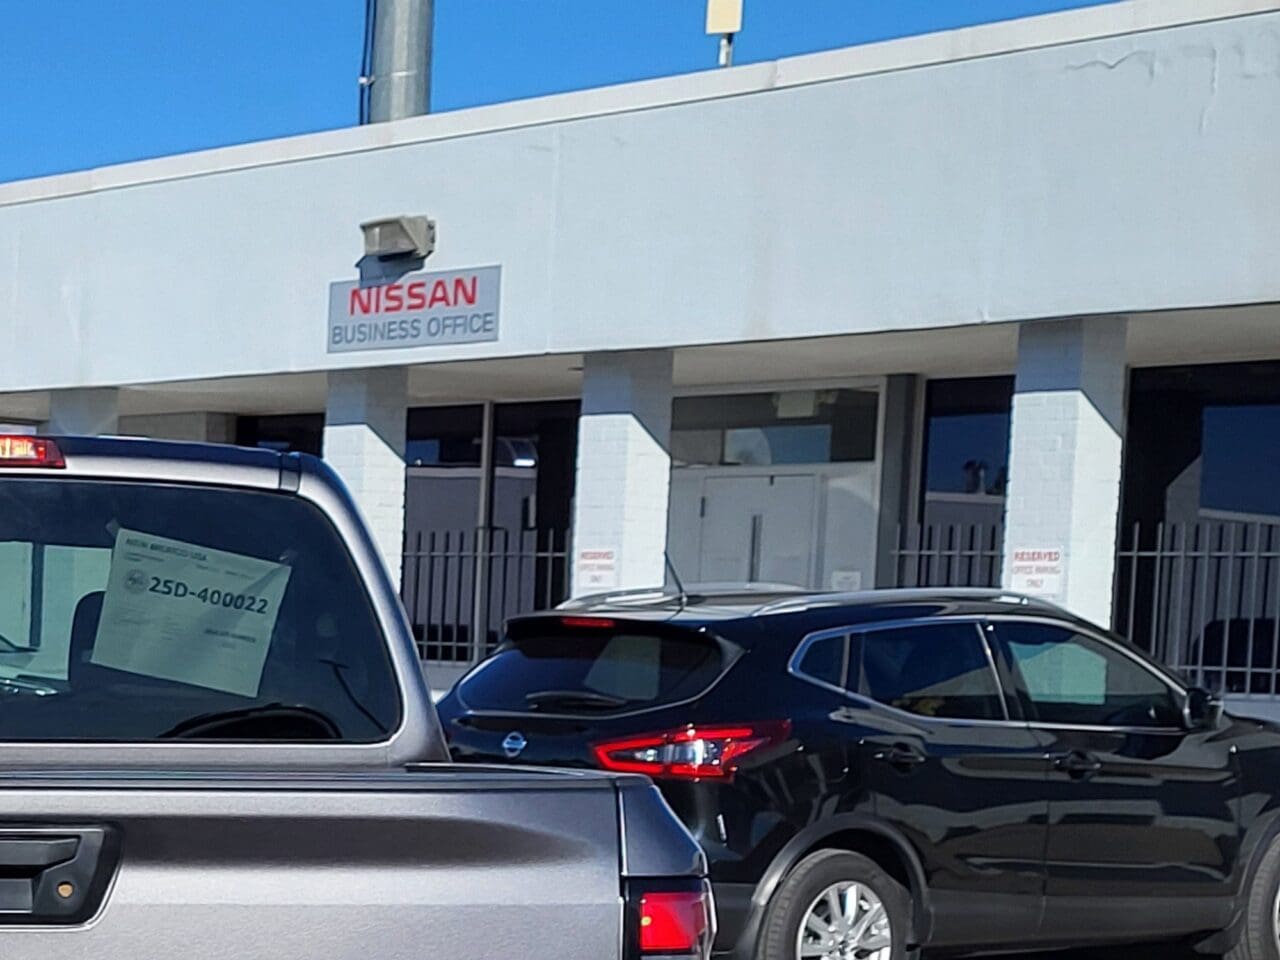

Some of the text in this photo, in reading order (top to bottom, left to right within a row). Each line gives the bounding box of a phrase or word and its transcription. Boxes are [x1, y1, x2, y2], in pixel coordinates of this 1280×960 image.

[349, 276, 478, 316] NISSAN
[331, 312, 495, 345] BUSINESS OFFICE
[1014, 551, 1060, 562] RESERVED
[148, 576, 269, 615] 25D-400022
